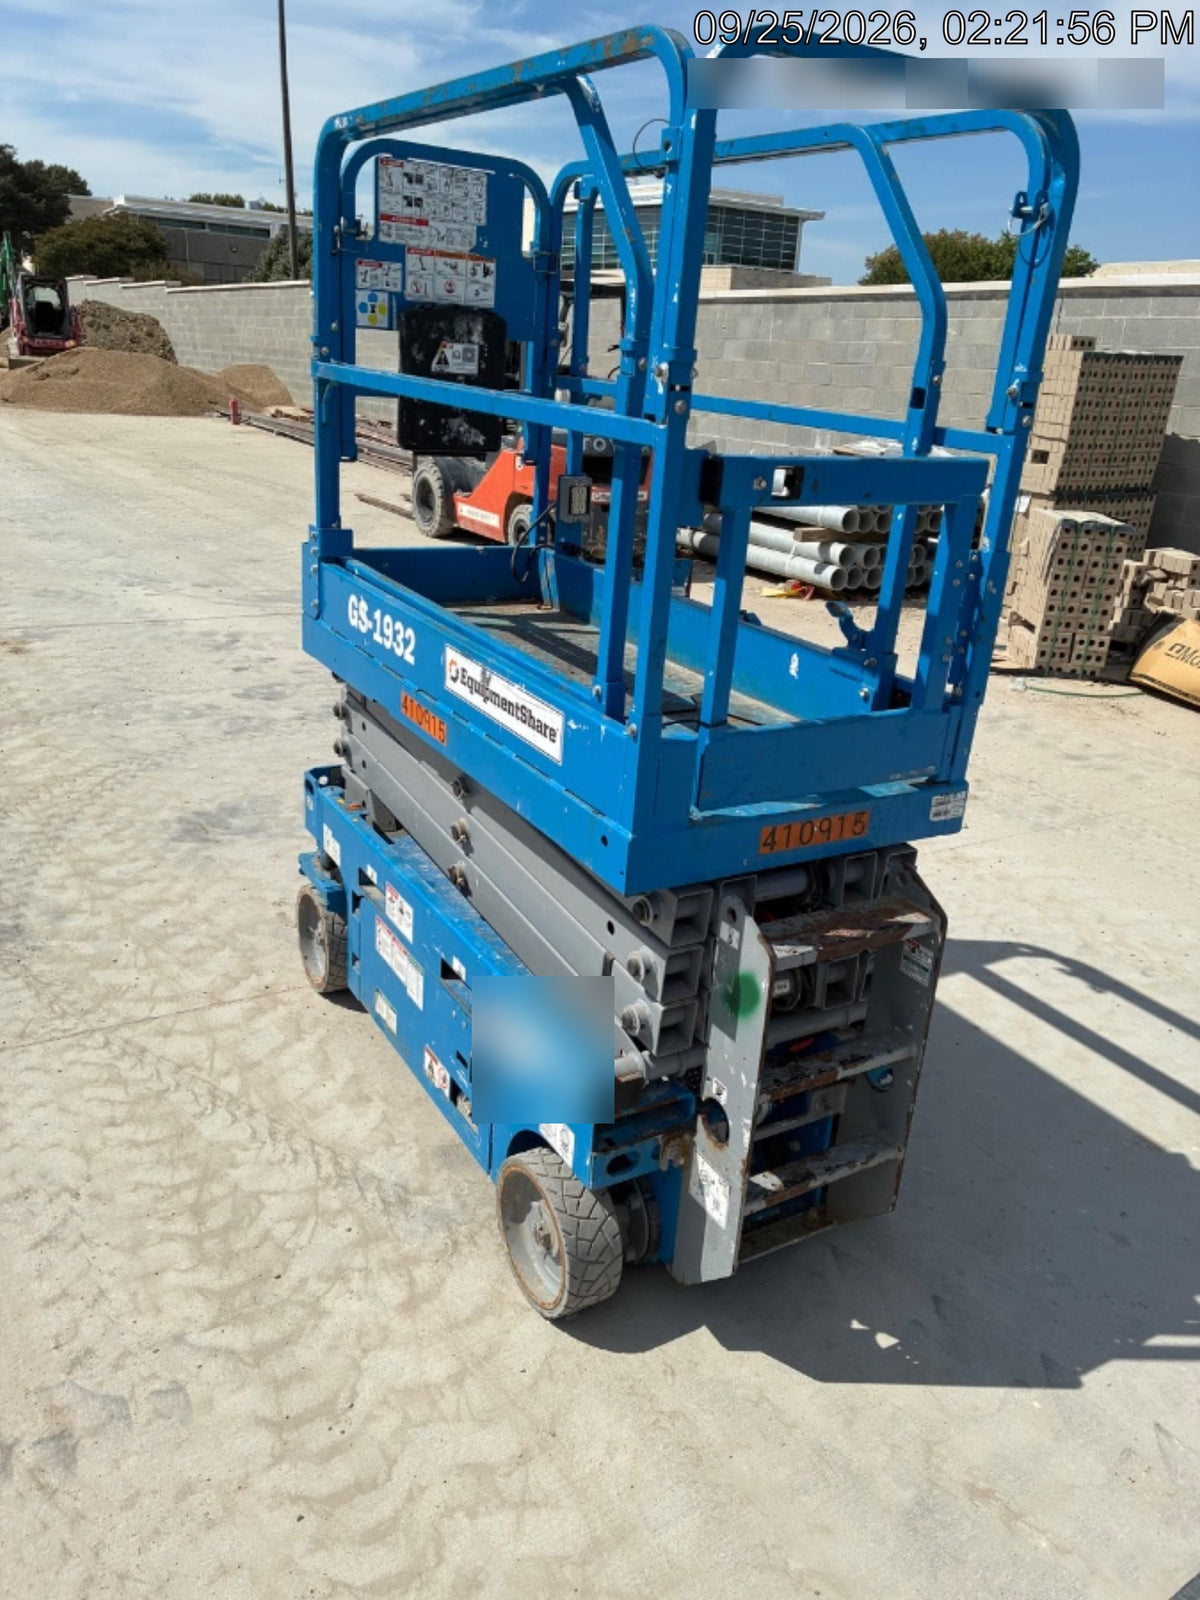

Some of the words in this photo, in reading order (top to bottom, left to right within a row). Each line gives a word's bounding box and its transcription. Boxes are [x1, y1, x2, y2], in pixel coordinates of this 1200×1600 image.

[347, 593, 416, 666] GS-1932
[401, 694, 446, 743] 410915
[460, 667, 557, 743] EquipmentShare
[762, 811, 867, 850] 410915
